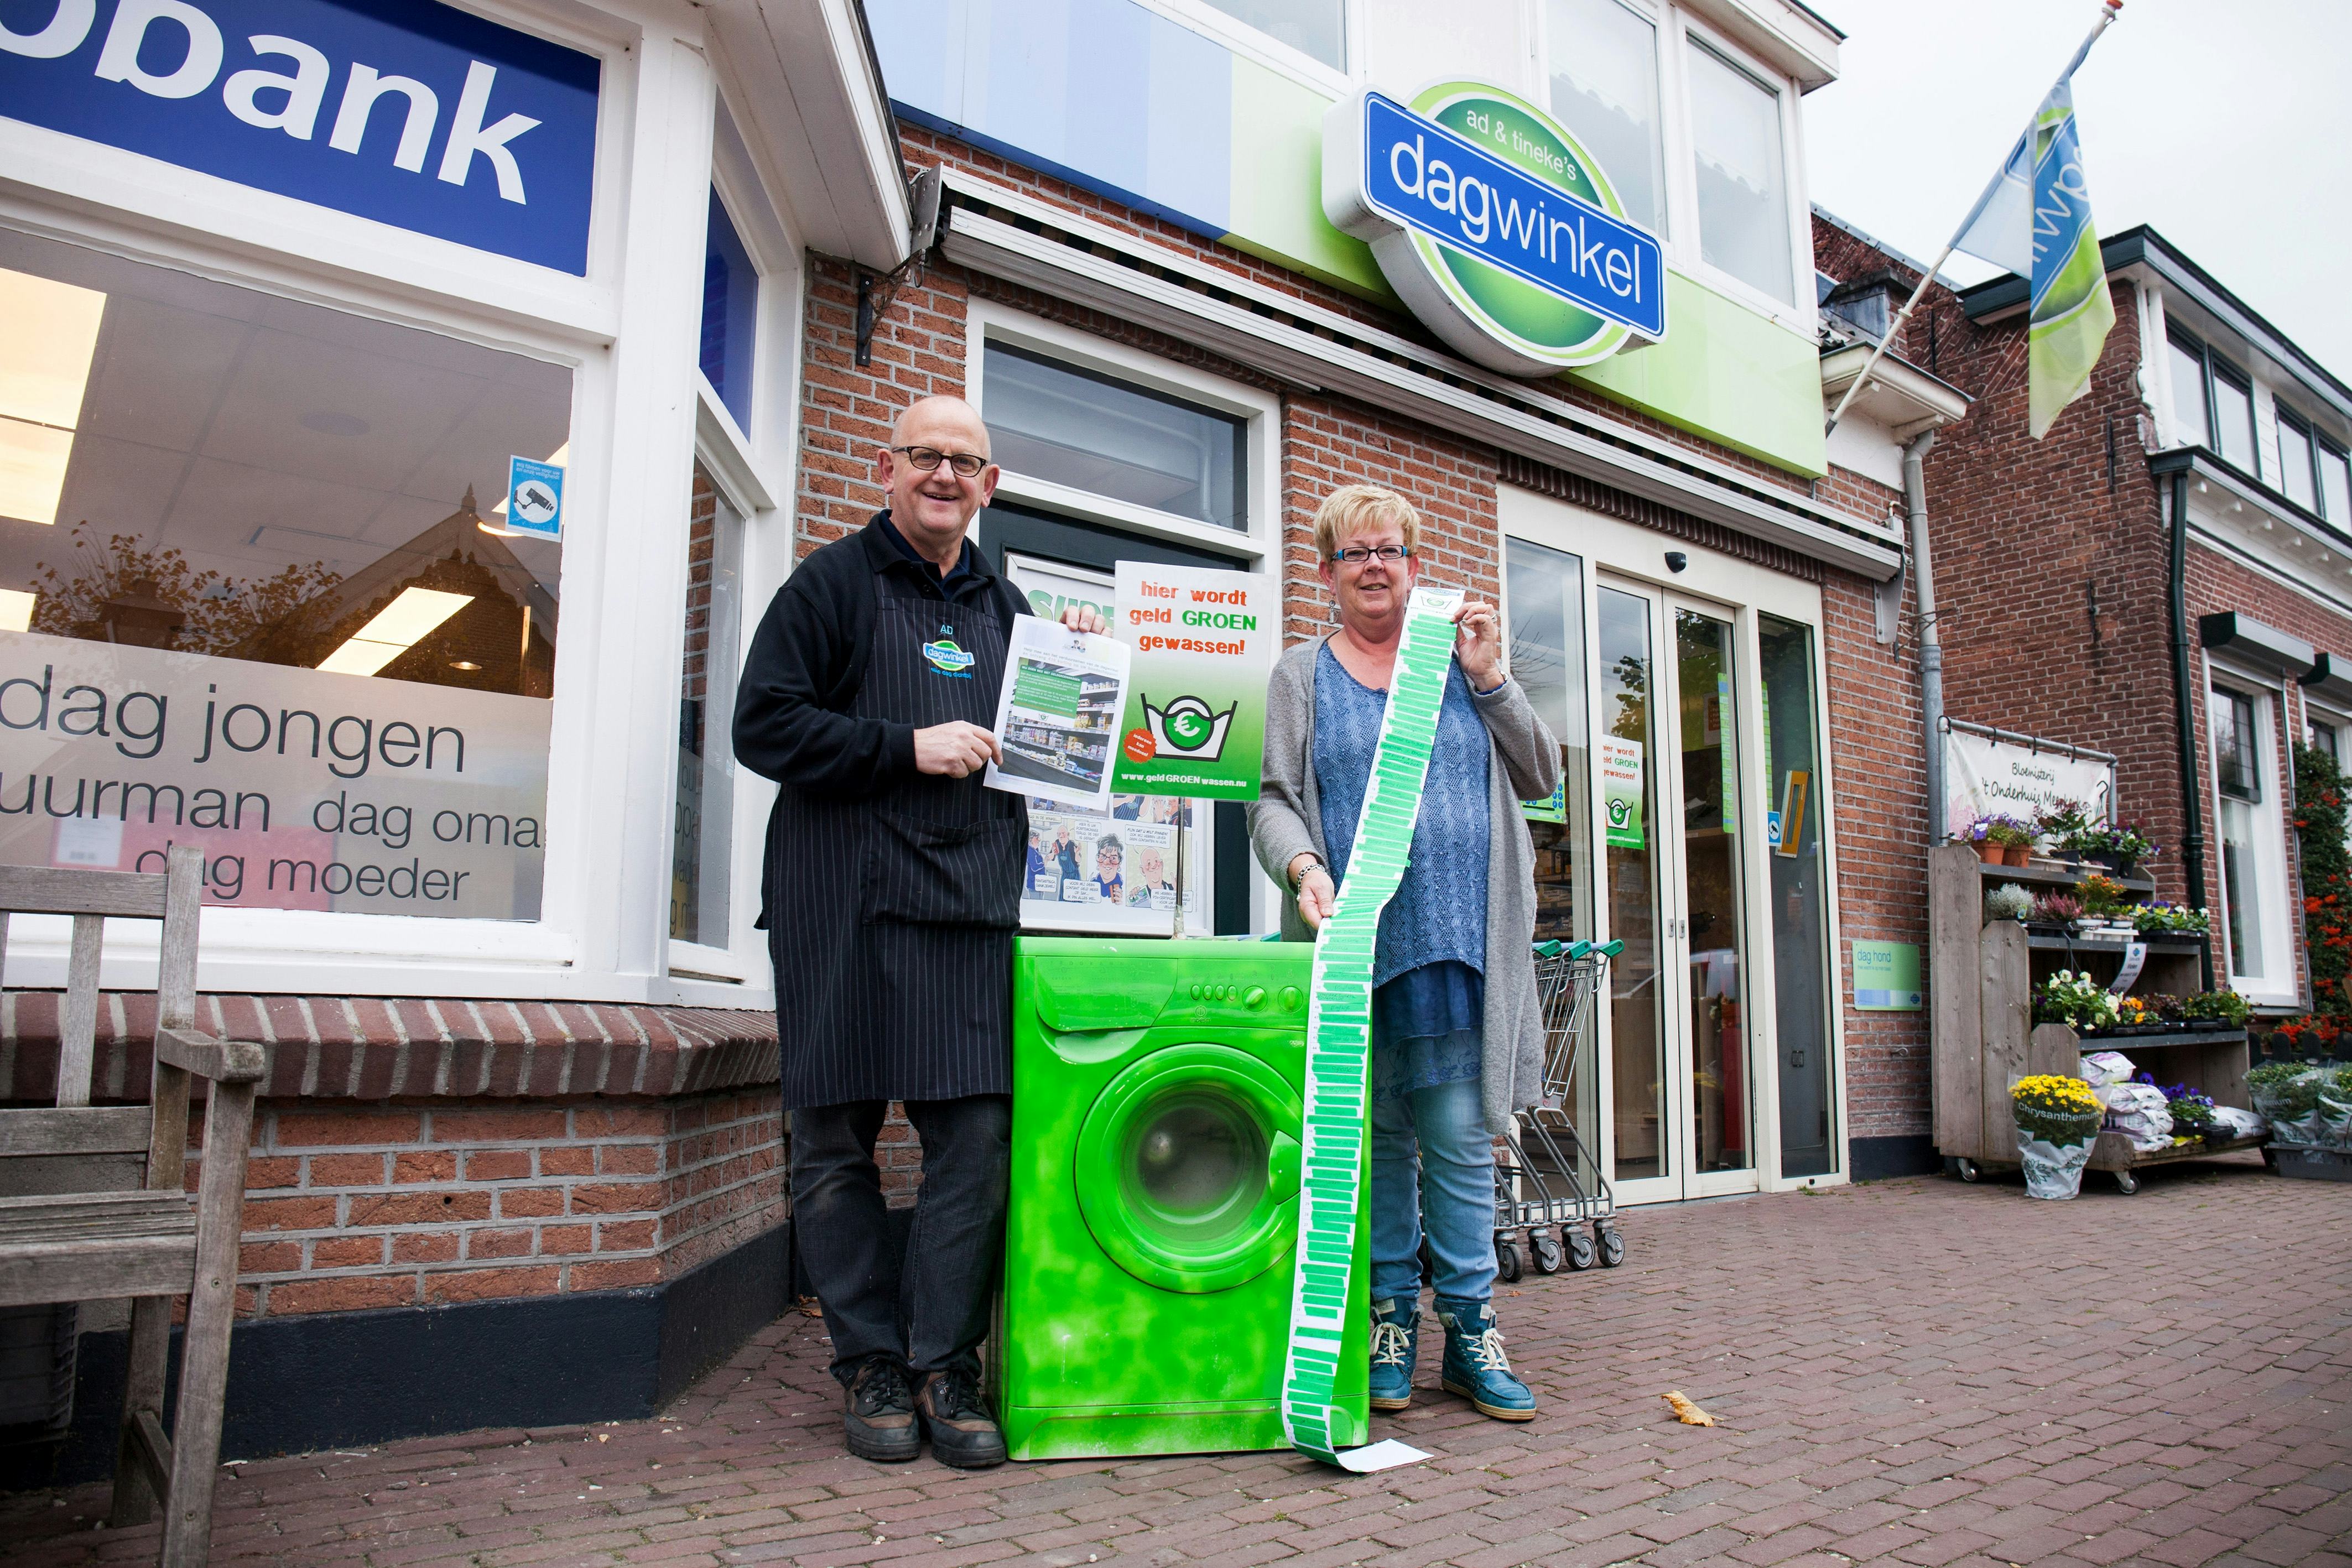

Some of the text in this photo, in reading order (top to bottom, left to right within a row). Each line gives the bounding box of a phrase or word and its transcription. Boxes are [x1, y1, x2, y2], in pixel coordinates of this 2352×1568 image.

[1467, 110, 1576, 181] ad & tineke's
[1390, 134, 1641, 304] dagwinkel
[1141, 581, 1247, 607] hier wordt
[940, 624, 953, 635] AD
[1129, 608, 1256, 631] geld GROEN
[928, 648, 969, 662] dagwinkel
[1139, 635, 1245, 656] gewassen!
[0, 663, 465, 779] dag jongen
[1133, 733, 1152, 745] iedereen
[1616, 748, 1635, 757] wordt
[1615, 758, 1638, 769] GROEN
[313, 790, 412, 849] dag
[433, 809, 540, 848] oma
[136, 840, 470, 901] dg moeder
[1857, 949, 1891, 964] dag hond
[2018, 1102, 2100, 1122] Chrysanthemum
